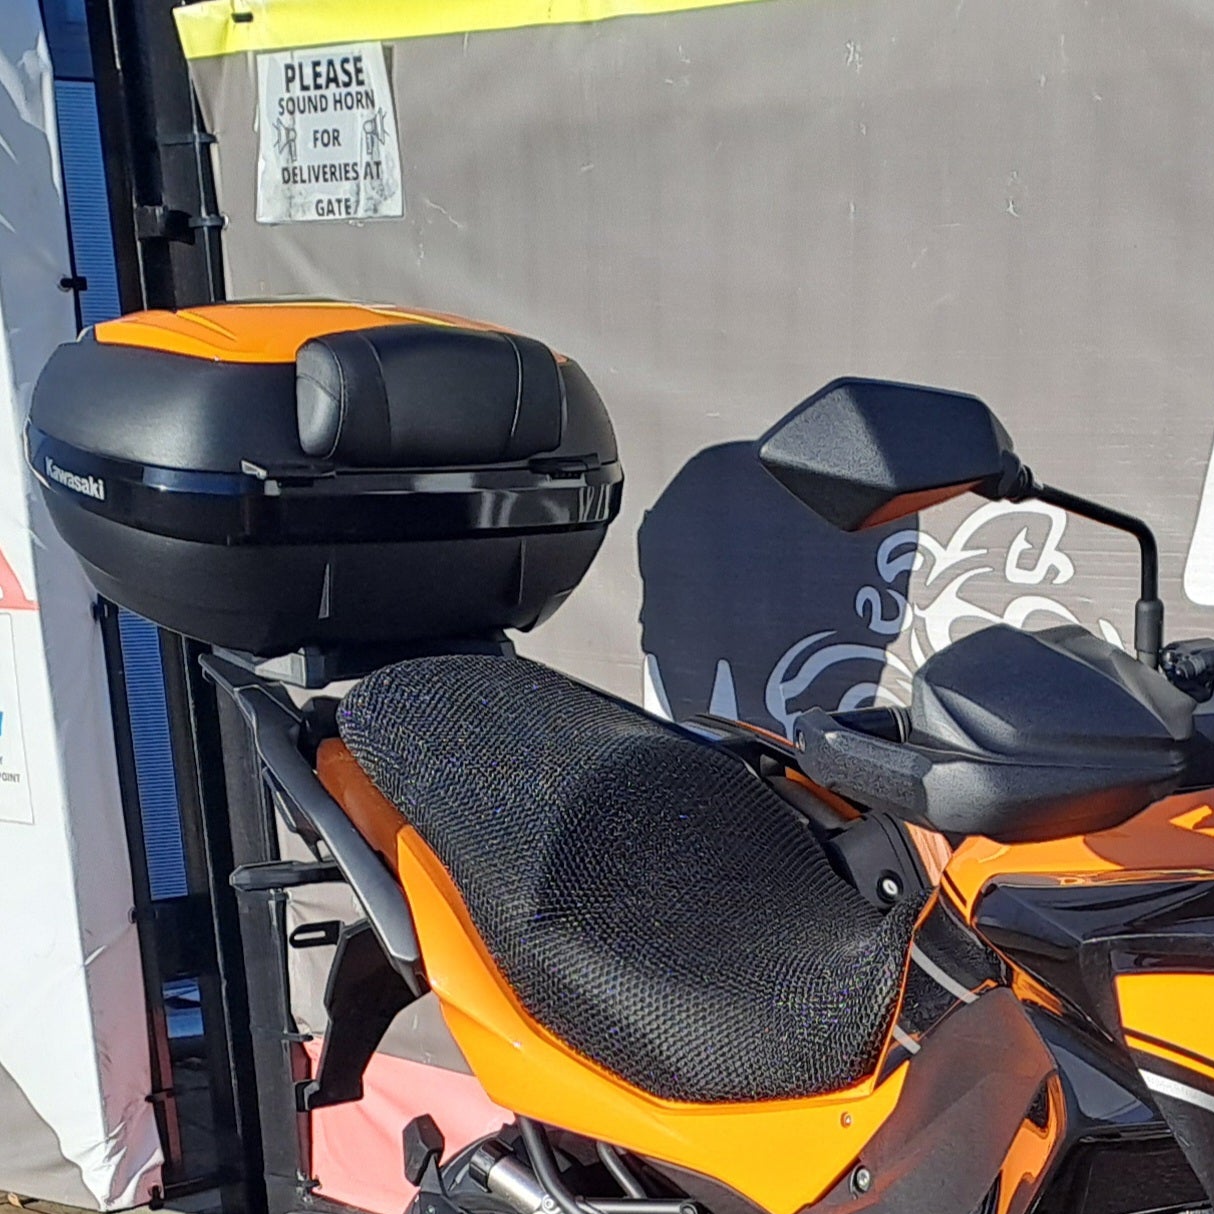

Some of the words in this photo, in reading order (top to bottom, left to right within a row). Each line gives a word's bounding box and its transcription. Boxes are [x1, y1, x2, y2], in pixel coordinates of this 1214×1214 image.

[284, 55, 366, 93] PLEASE
[278, 94, 329, 116] SOUND
[333, 89, 376, 112] HORN
[312, 128, 342, 149] FOR
[281, 162, 360, 185] DELIVERIES
[363, 160, 382, 181] AT
[315, 197, 352, 217] GATE
[45, 456, 105, 501] Kawasaki
[0, 770, 21, 784] OINT
